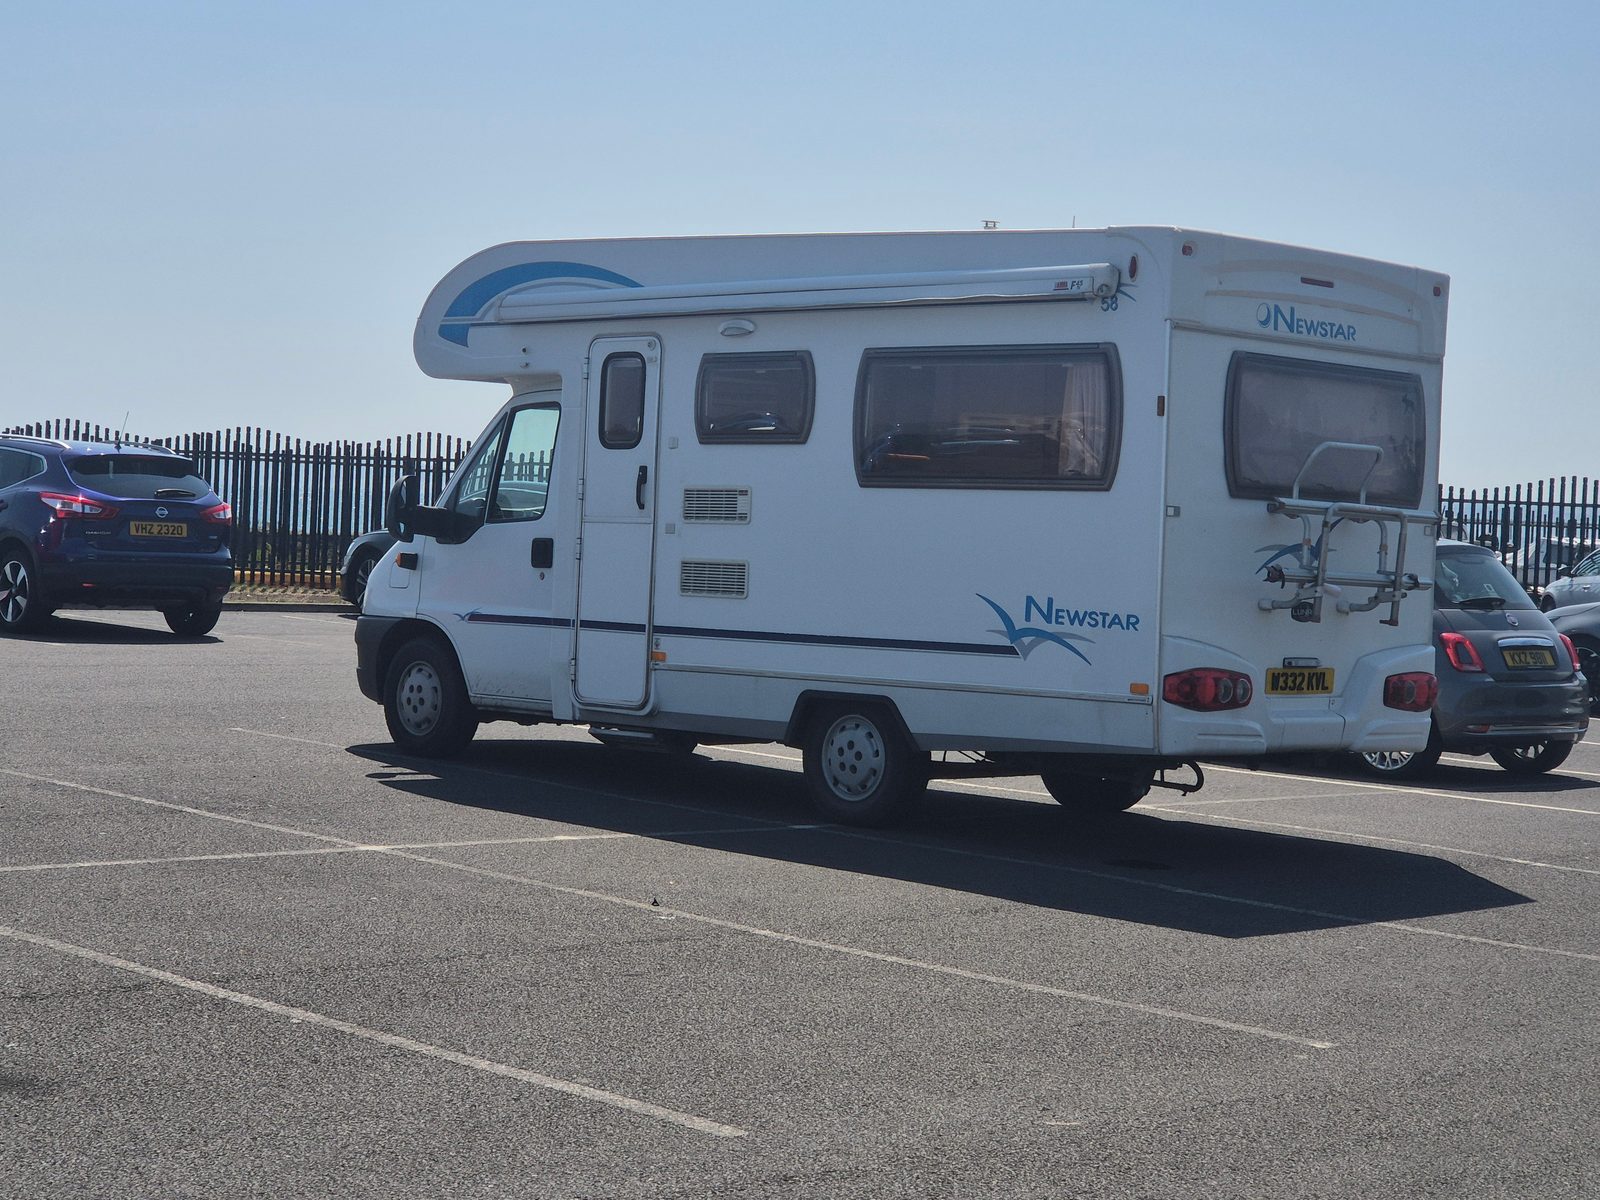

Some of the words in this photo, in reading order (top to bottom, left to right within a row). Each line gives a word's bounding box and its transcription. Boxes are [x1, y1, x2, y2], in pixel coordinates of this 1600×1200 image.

[1101, 295, 1119, 312] 58
[1273, 304, 1357, 341] NEWSTAR
[134, 523, 155, 535] VHZ
[157, 524, 184, 536] 2320
[1024, 595, 1140, 632] NEWSTAR
[1307, 672, 1329, 691] KVL
